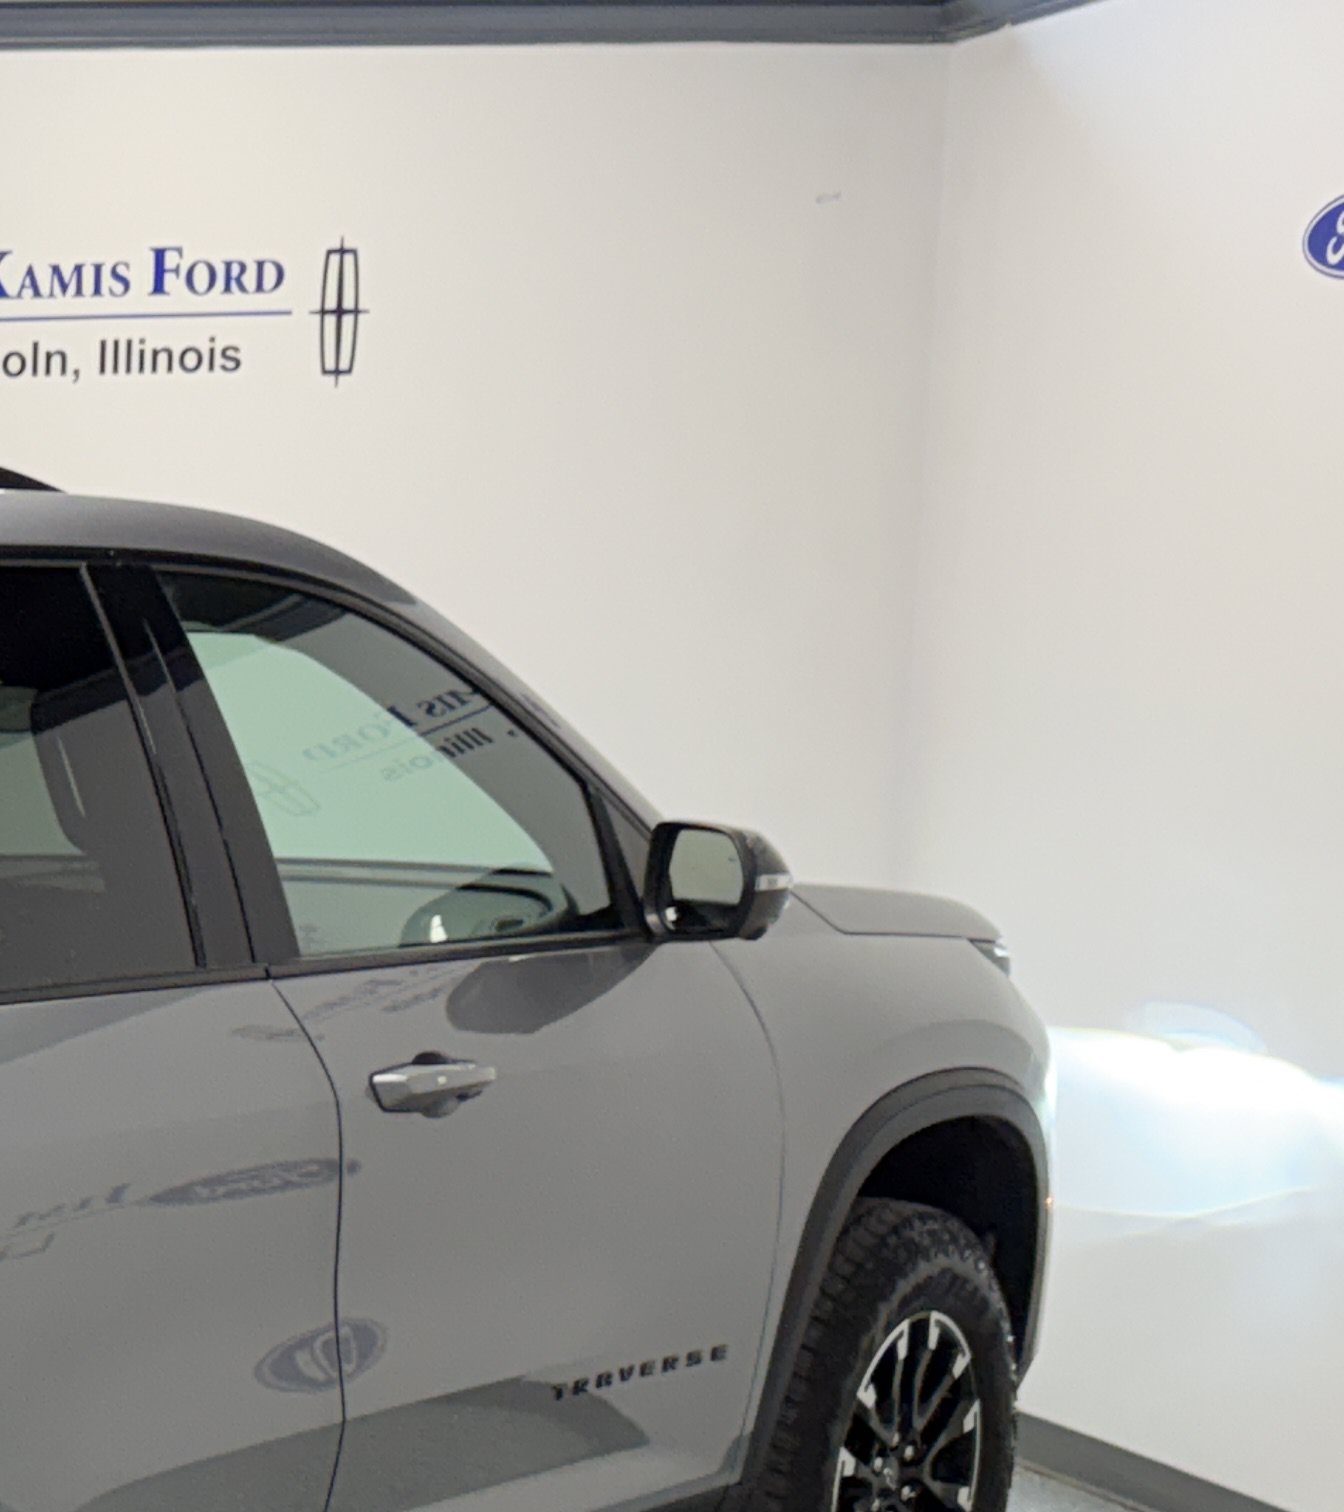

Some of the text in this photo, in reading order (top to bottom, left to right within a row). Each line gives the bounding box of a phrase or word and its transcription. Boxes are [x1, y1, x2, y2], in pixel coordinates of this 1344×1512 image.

[148, 246, 286, 297] FORD
[98, 336, 242, 376] Illinois
[551, 1344, 727, 1401] TRAVERSE
